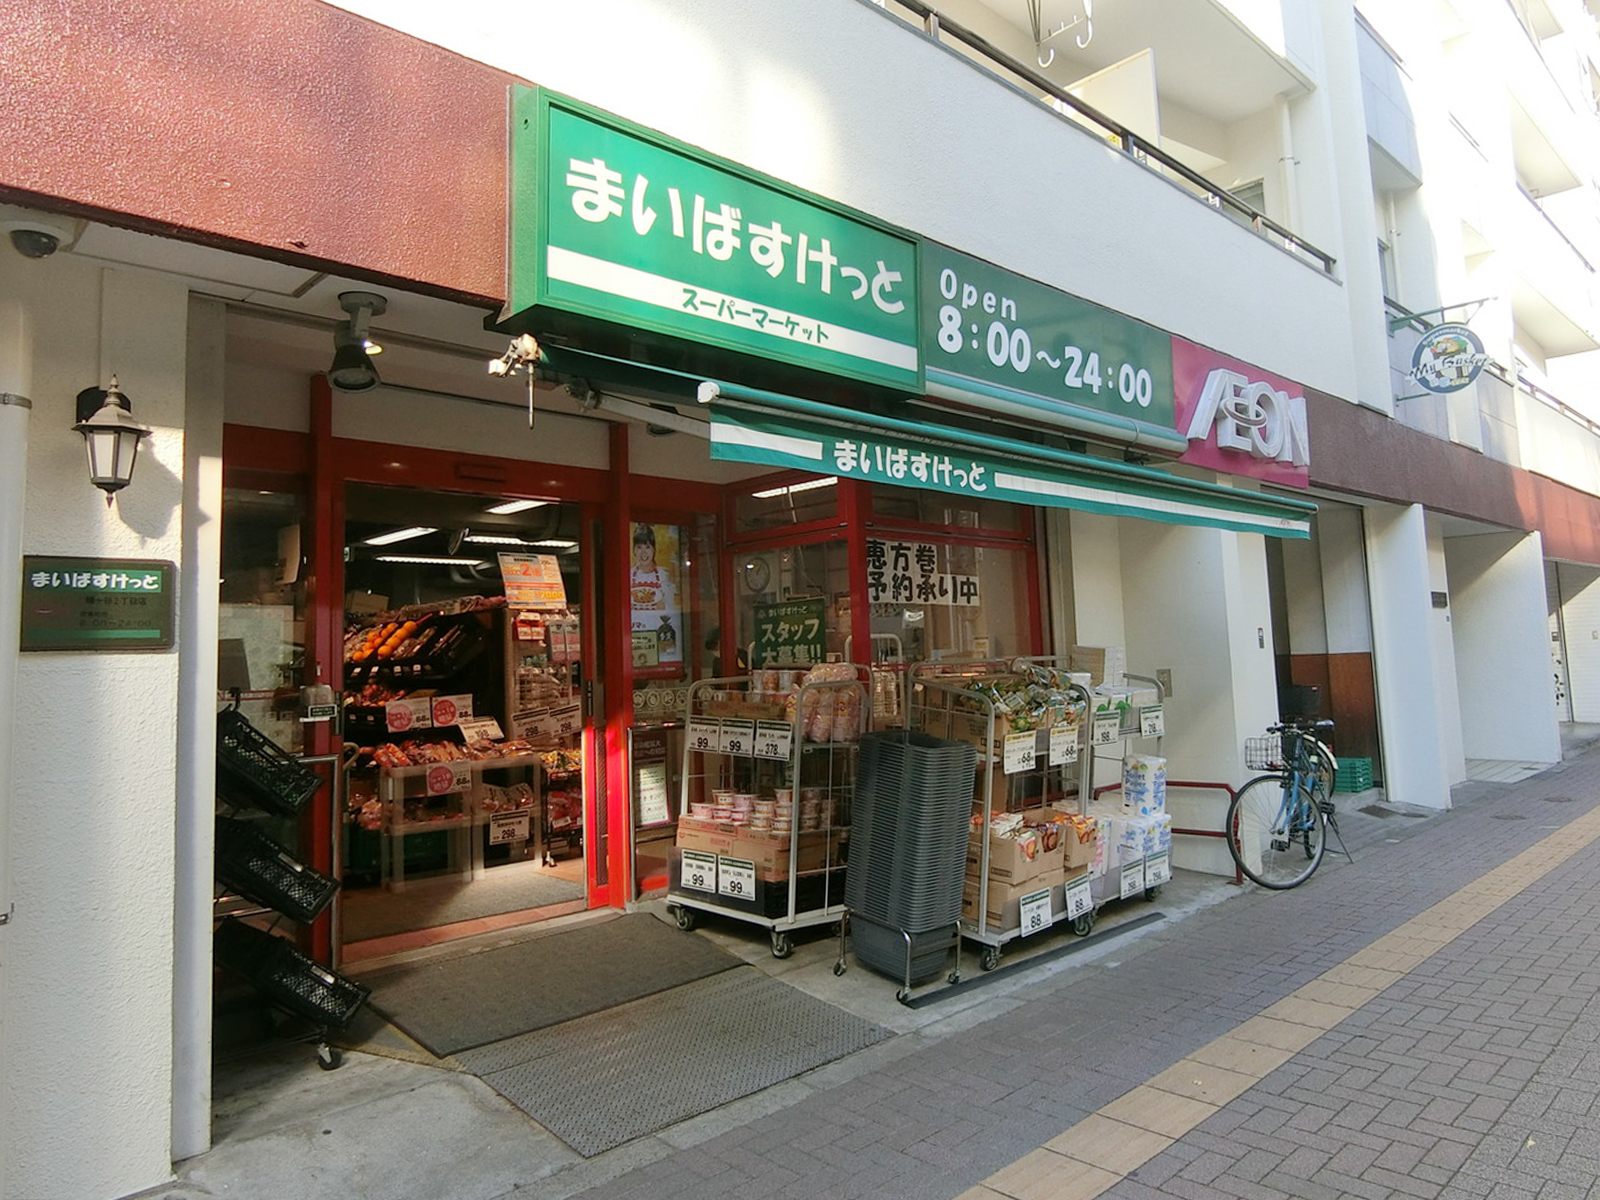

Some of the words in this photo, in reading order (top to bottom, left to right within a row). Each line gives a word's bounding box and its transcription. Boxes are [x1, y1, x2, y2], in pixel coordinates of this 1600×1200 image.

[565, 157, 905, 314] まいばすけっと
[939, 268, 1018, 322] Open
[681, 287, 829, 344] スーパーマーケット
[1442, 353, 1488, 369] Basket
[1187, 367, 1311, 467] AEON
[833, 439, 987, 492] まいばすけっと
[866, 539, 937, 574] 恵方巻
[31, 571, 160, 590] まいばすけっと
[867, 571, 979, 605] 予約承り中
[760, 618, 821, 644] スタッフ
[696, 736, 709, 749] 99
[728, 740, 742, 752] 99
[691, 873, 705, 887] 99
[729, 880, 743, 894] 99
[1030, 913, 1042, 929] 88
